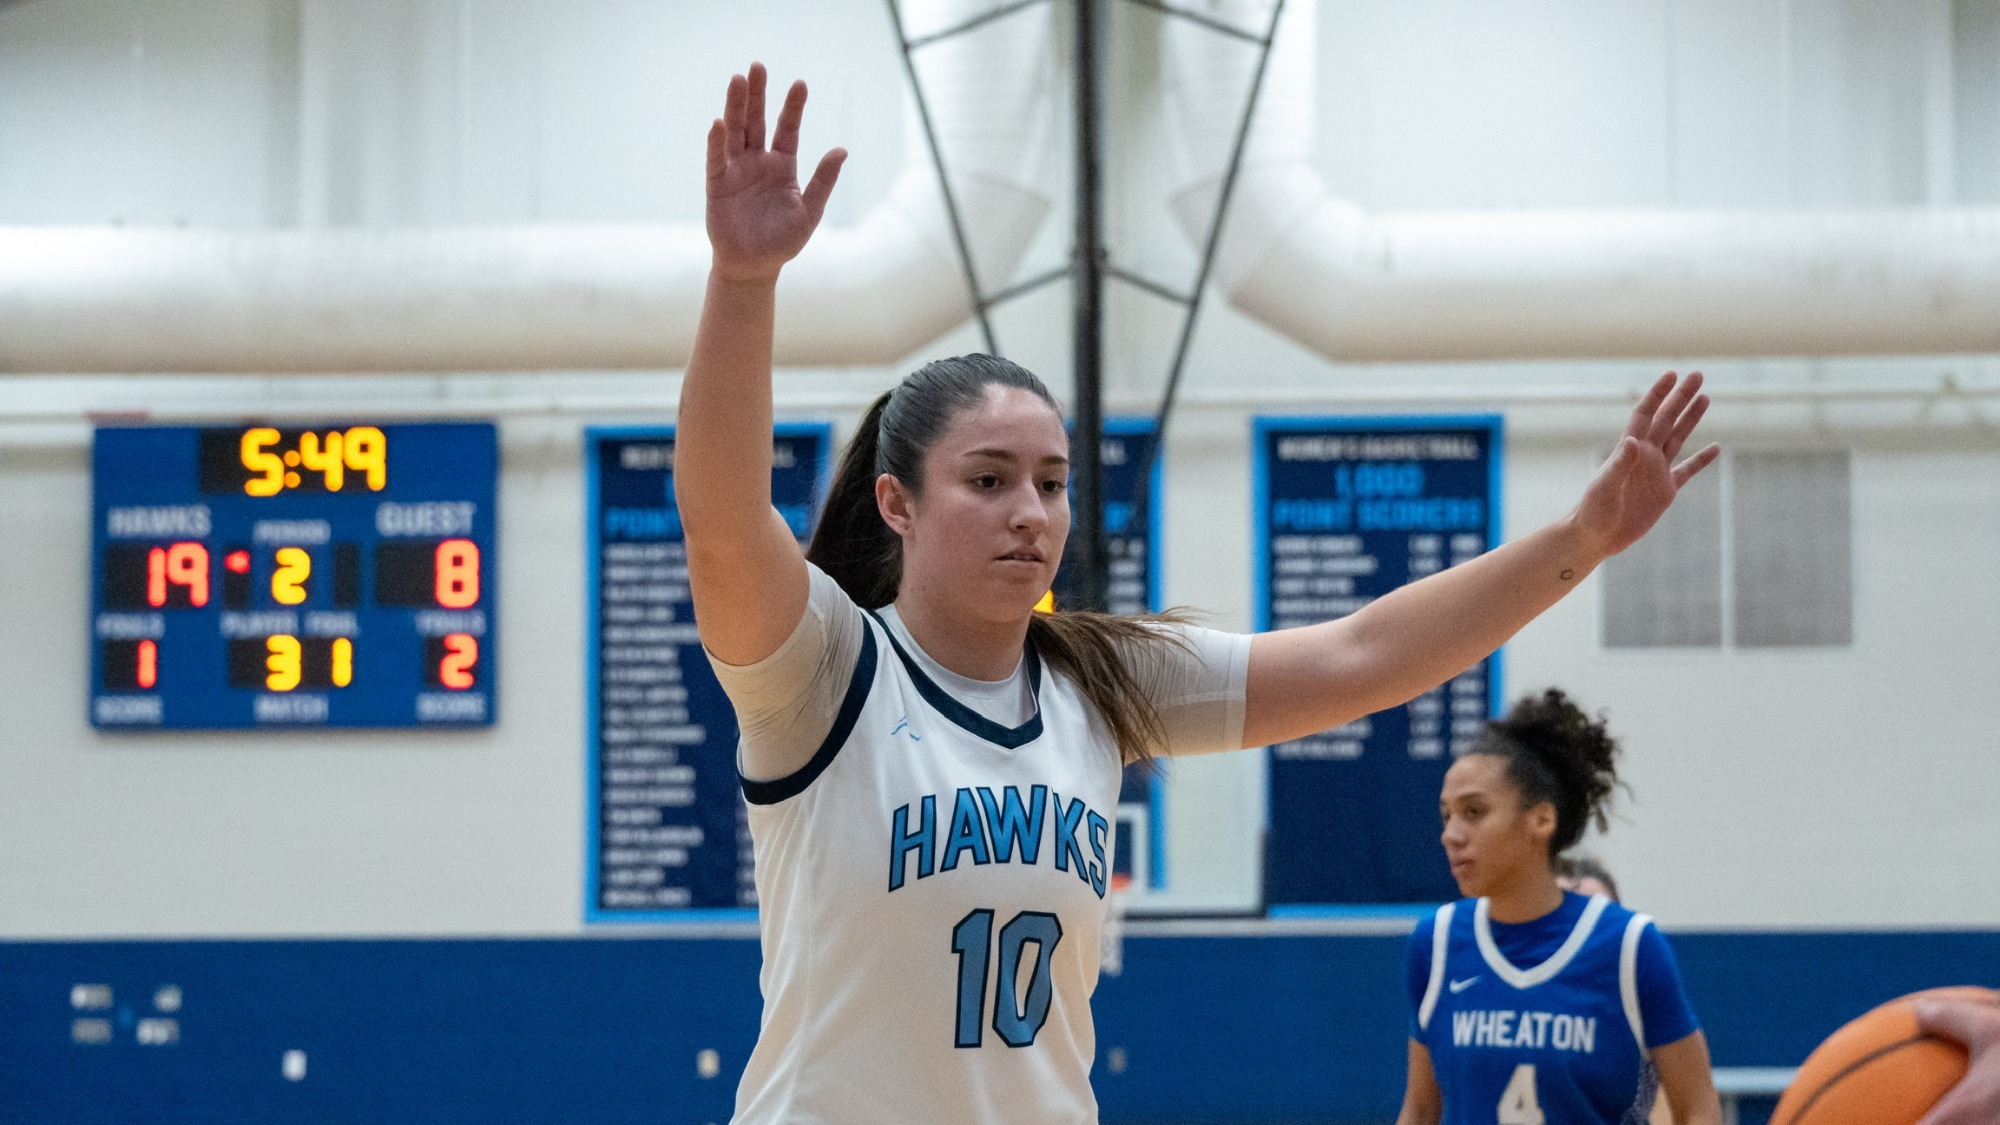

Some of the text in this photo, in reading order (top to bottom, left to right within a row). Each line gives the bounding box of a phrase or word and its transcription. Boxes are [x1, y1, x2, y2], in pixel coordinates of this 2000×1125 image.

[240, 426, 387, 497] 5:49
[107, 505, 212, 537] HAWKS
[375, 501, 476, 535] GUEST
[1273, 500, 1483, 531] POINT SCORERS
[147, 541, 210, 607] 19
[270, 546, 312, 605] 2
[434, 538, 480, 608] 8
[137, 639, 157, 688] 1
[439, 633, 479, 690] 2
[888, 784, 1109, 900] HAWKS
[951, 908, 1064, 1049] 10
[1452, 1009, 1597, 1054] WHEATON
[1496, 1063, 1546, 1125] 4
